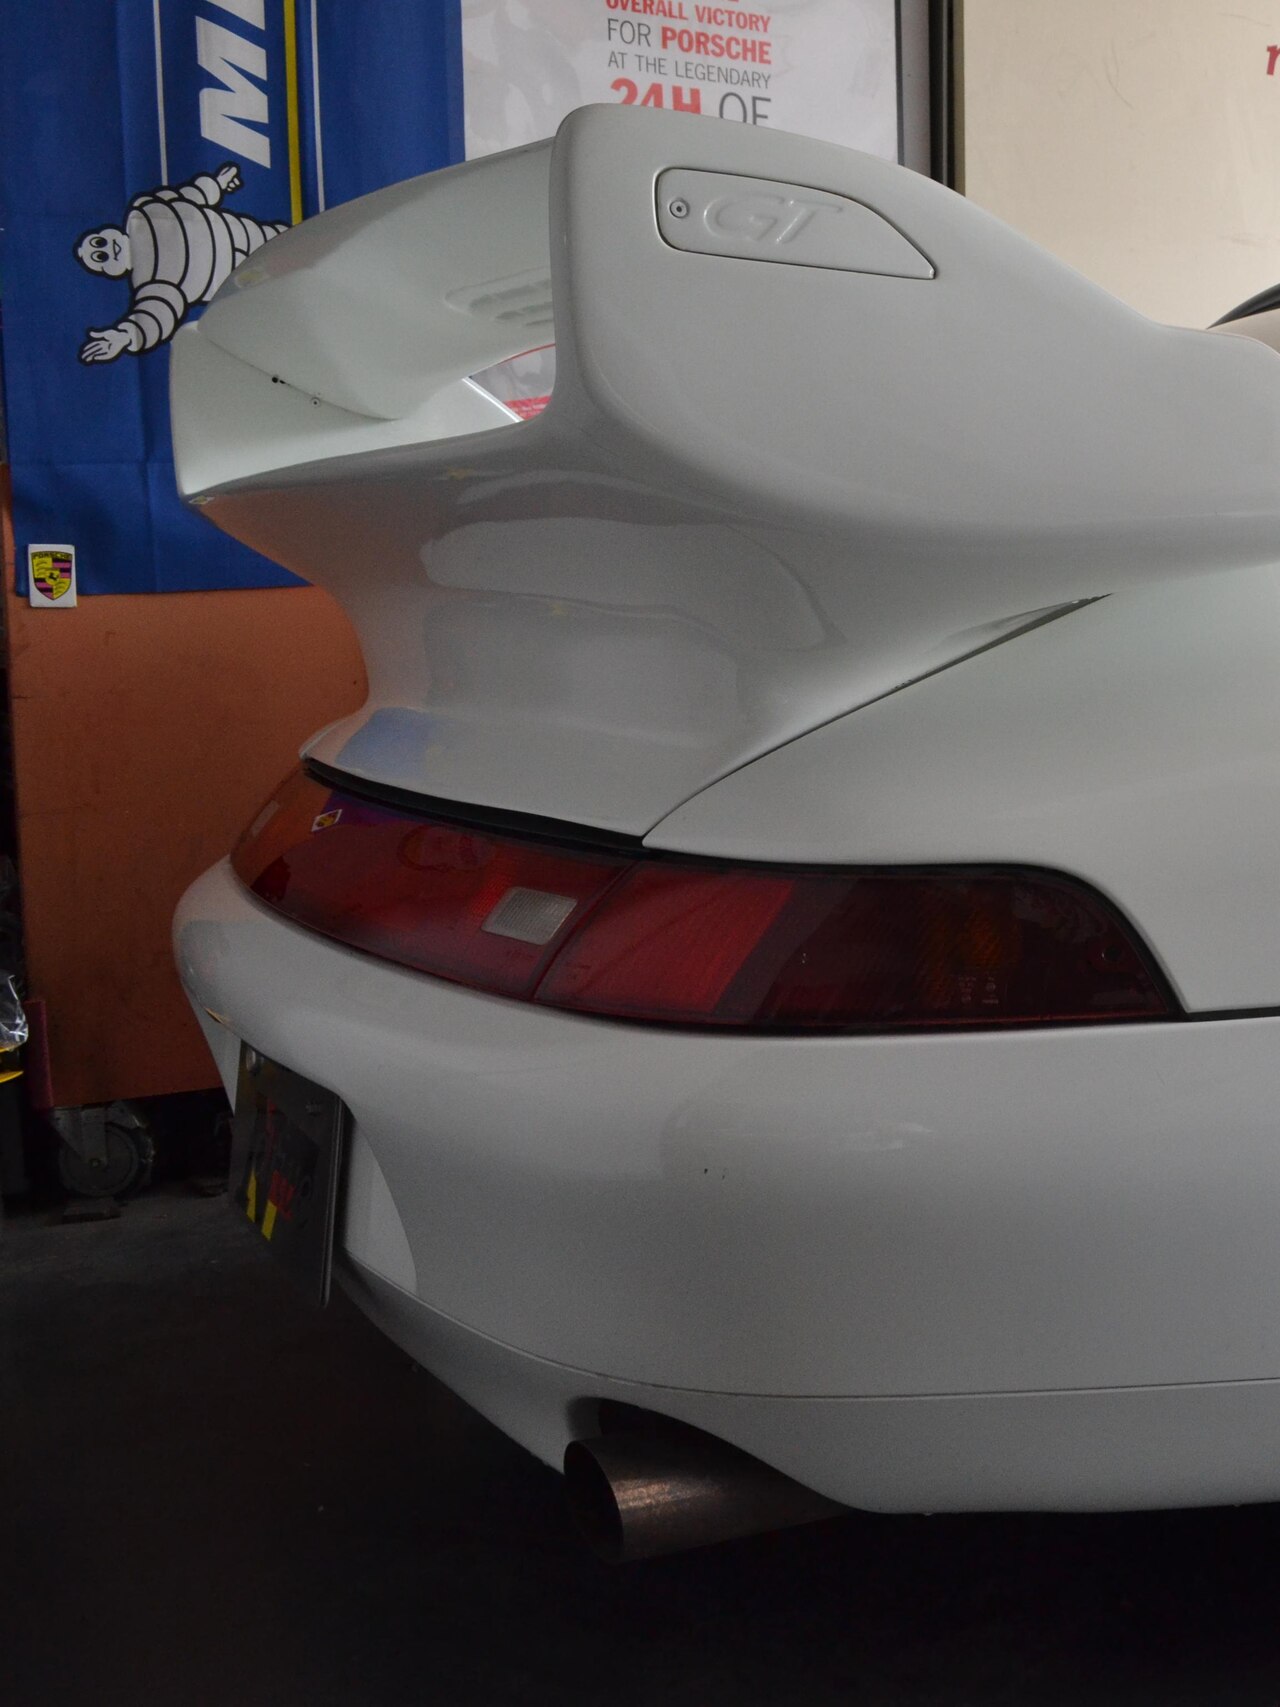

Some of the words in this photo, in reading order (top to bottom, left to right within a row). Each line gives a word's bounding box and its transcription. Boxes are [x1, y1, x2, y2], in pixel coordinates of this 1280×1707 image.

[605, 0, 689, 20] OVERALL
[695, 5, 771, 33] VICTORY
[607, 18, 651, 47] FOR
[661, 26, 772, 64] PORSCHE
[607, 51, 628, 69] AT
[635, 54, 668, 75] THE
[675, 60, 771, 89] LEGENDARY
[610, 77, 702, 115] 24H
[719, 92, 771, 125] OF
[703, 196, 844, 245] GT
